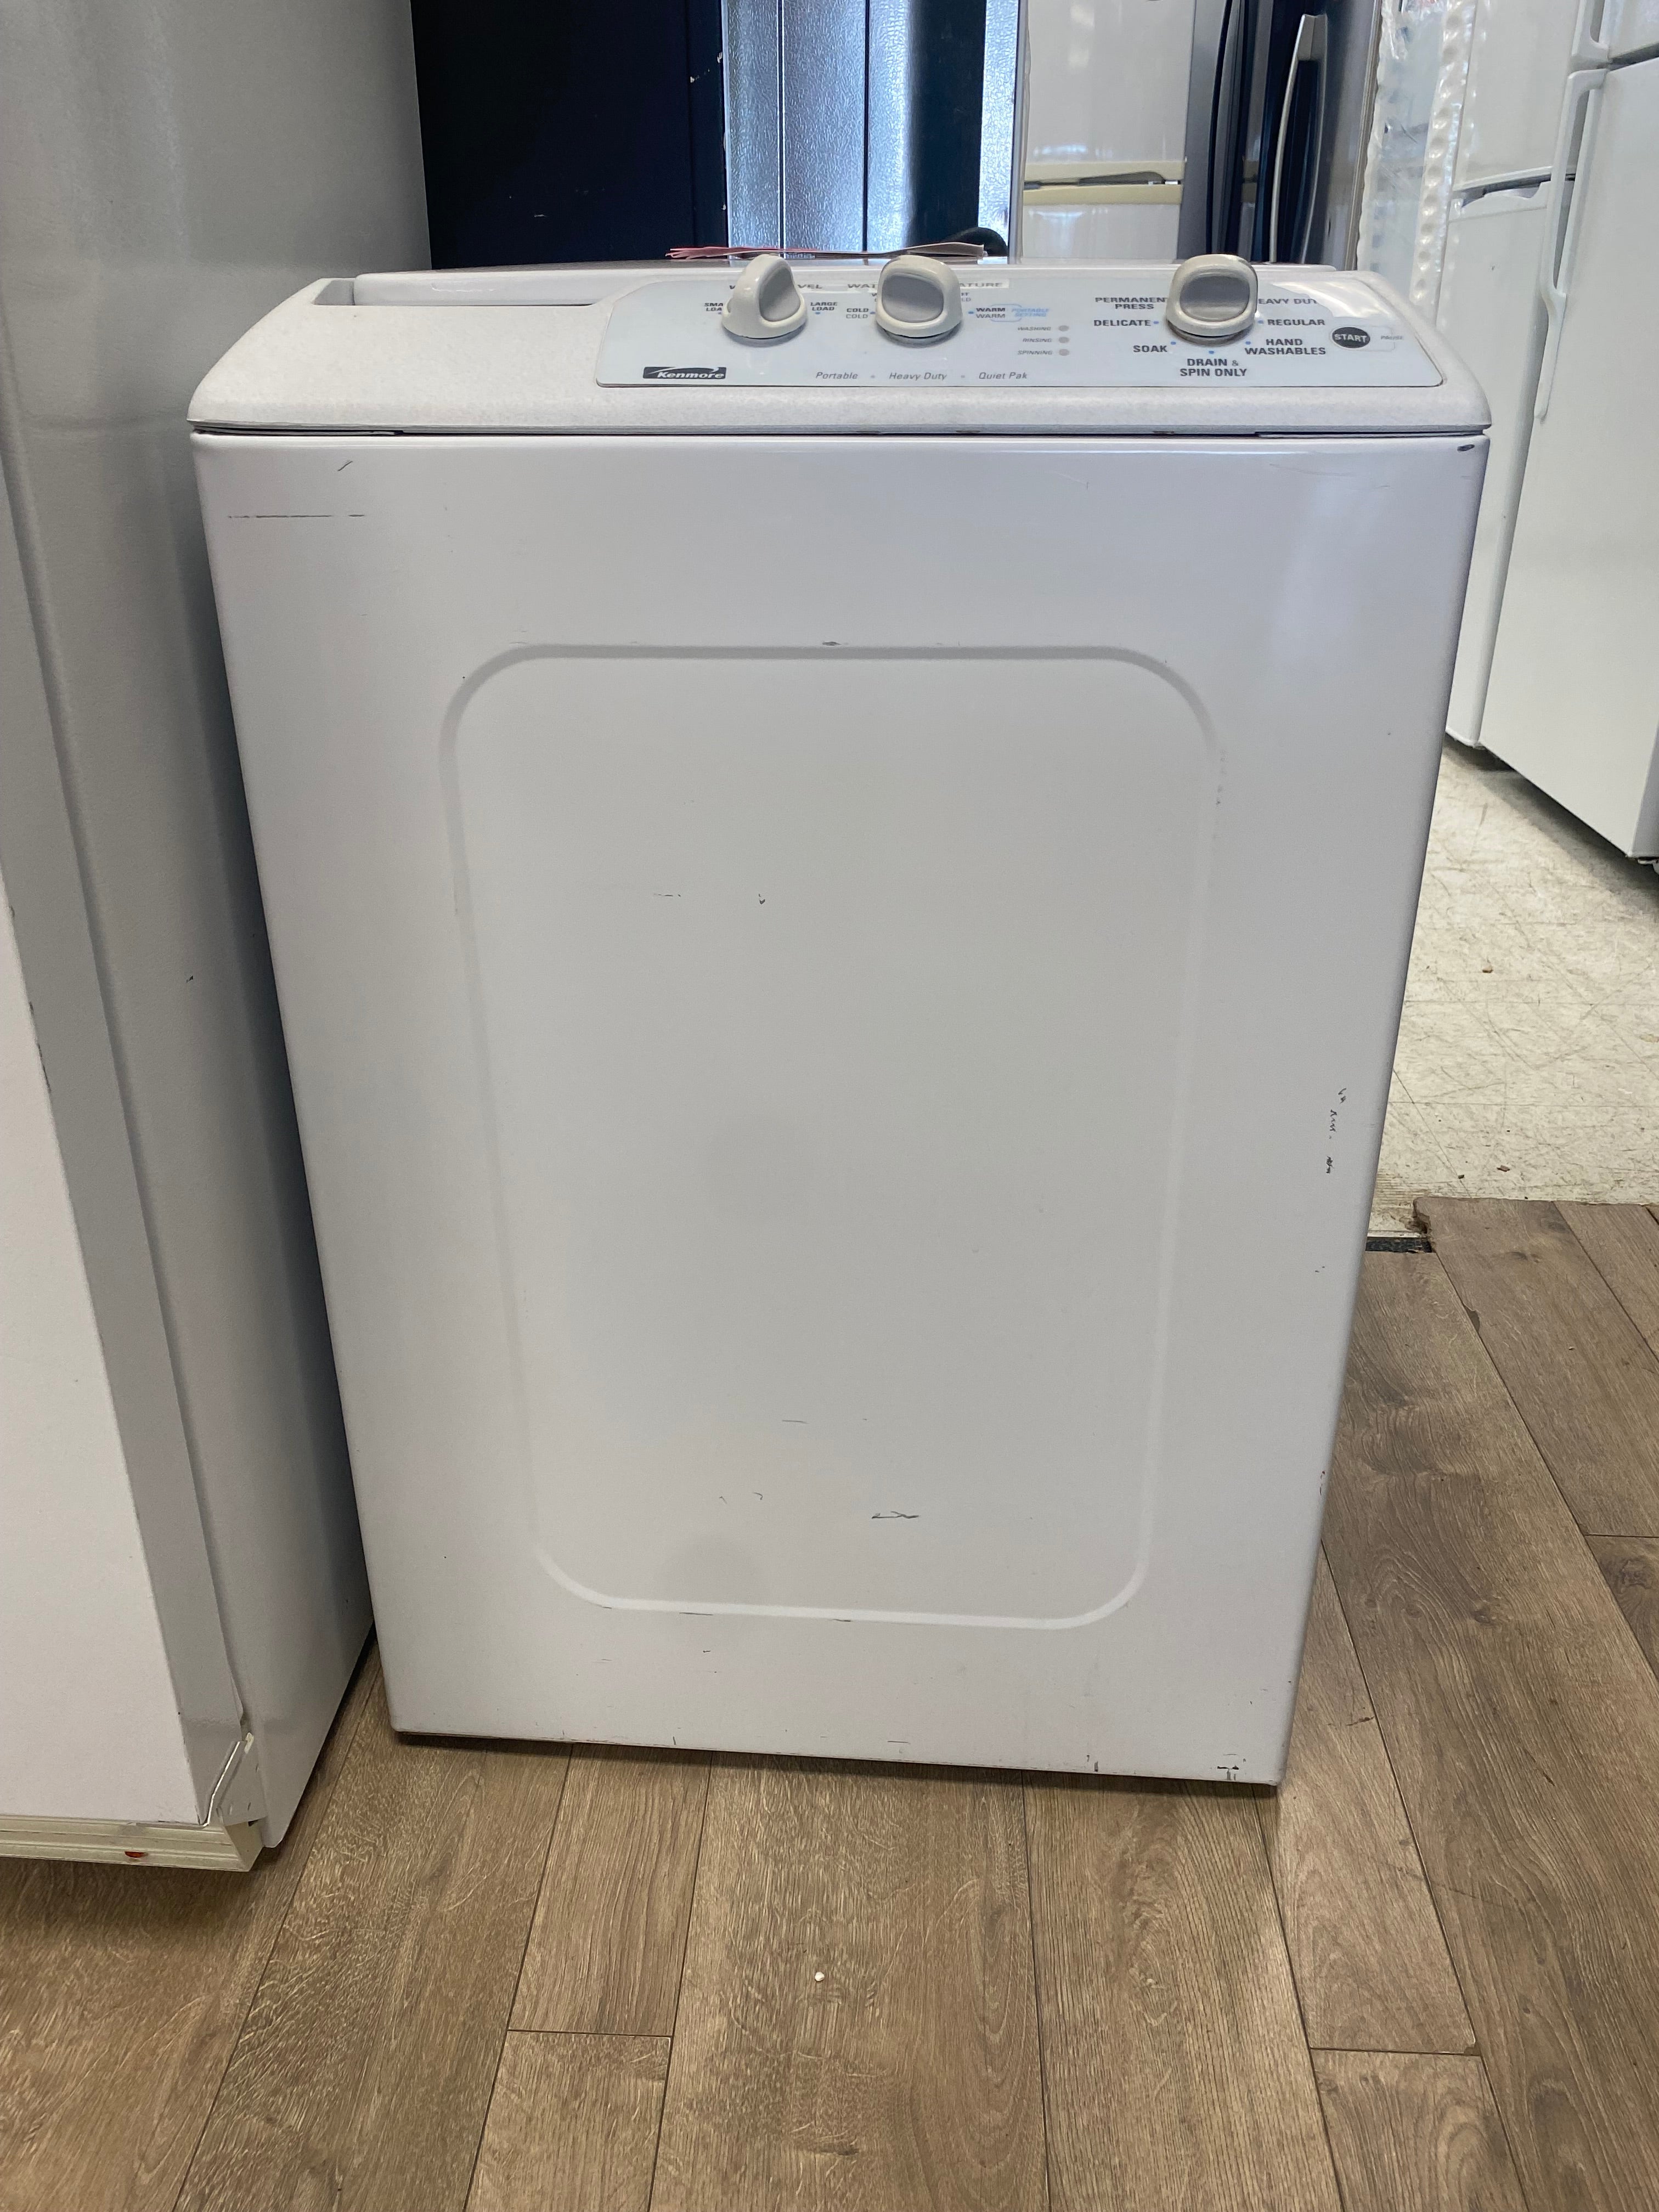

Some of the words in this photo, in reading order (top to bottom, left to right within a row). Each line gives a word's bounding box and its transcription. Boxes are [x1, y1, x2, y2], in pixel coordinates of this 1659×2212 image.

[1334, 333, 1368, 343] START
[1244, 347, 1327, 355] WASHABLES
[1187, 358, 1227, 366] DRAIN
[657, 370, 725, 380] Kenmore
[815, 371, 859, 380] Portable
[889, 372, 922, 381] Heavy
[923, 372, 947, 381] Duty
[978, 372, 1006, 380] Quiet
[1180, 368, 1210, 377] SPIN
[1215, 368, 1247, 377] ONLY
